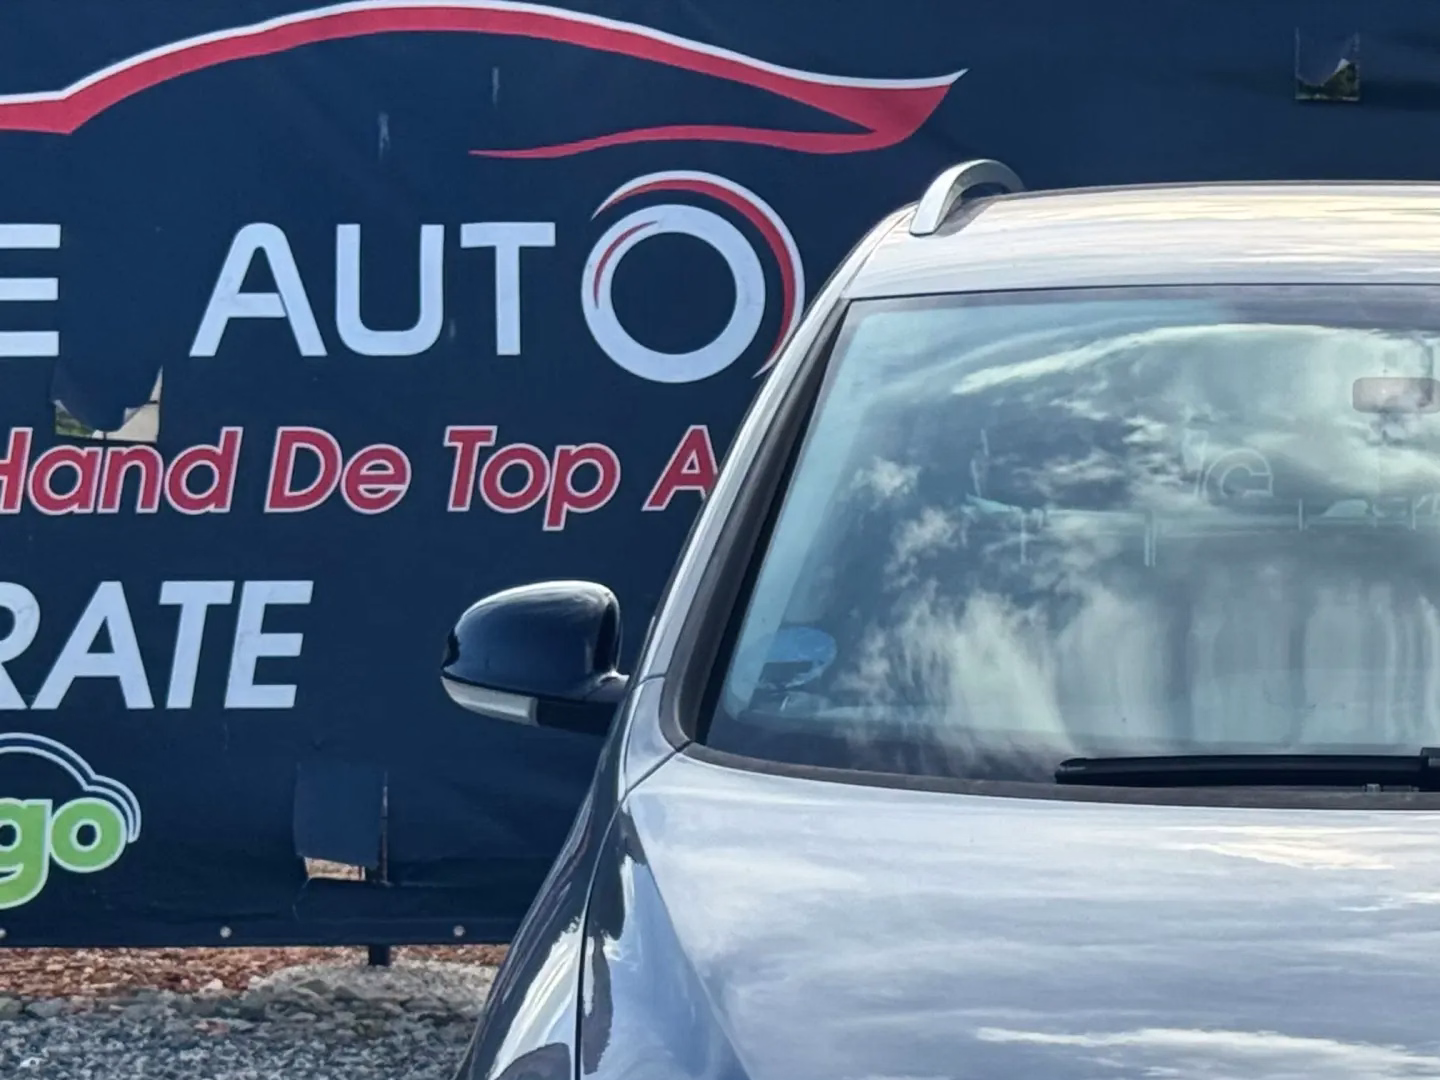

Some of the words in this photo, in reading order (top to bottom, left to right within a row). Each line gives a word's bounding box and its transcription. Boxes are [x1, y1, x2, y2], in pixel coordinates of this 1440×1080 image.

[189, 204, 767, 384] AUTO
[264, 426, 411, 515] De
[443, 424, 621, 532] Top
